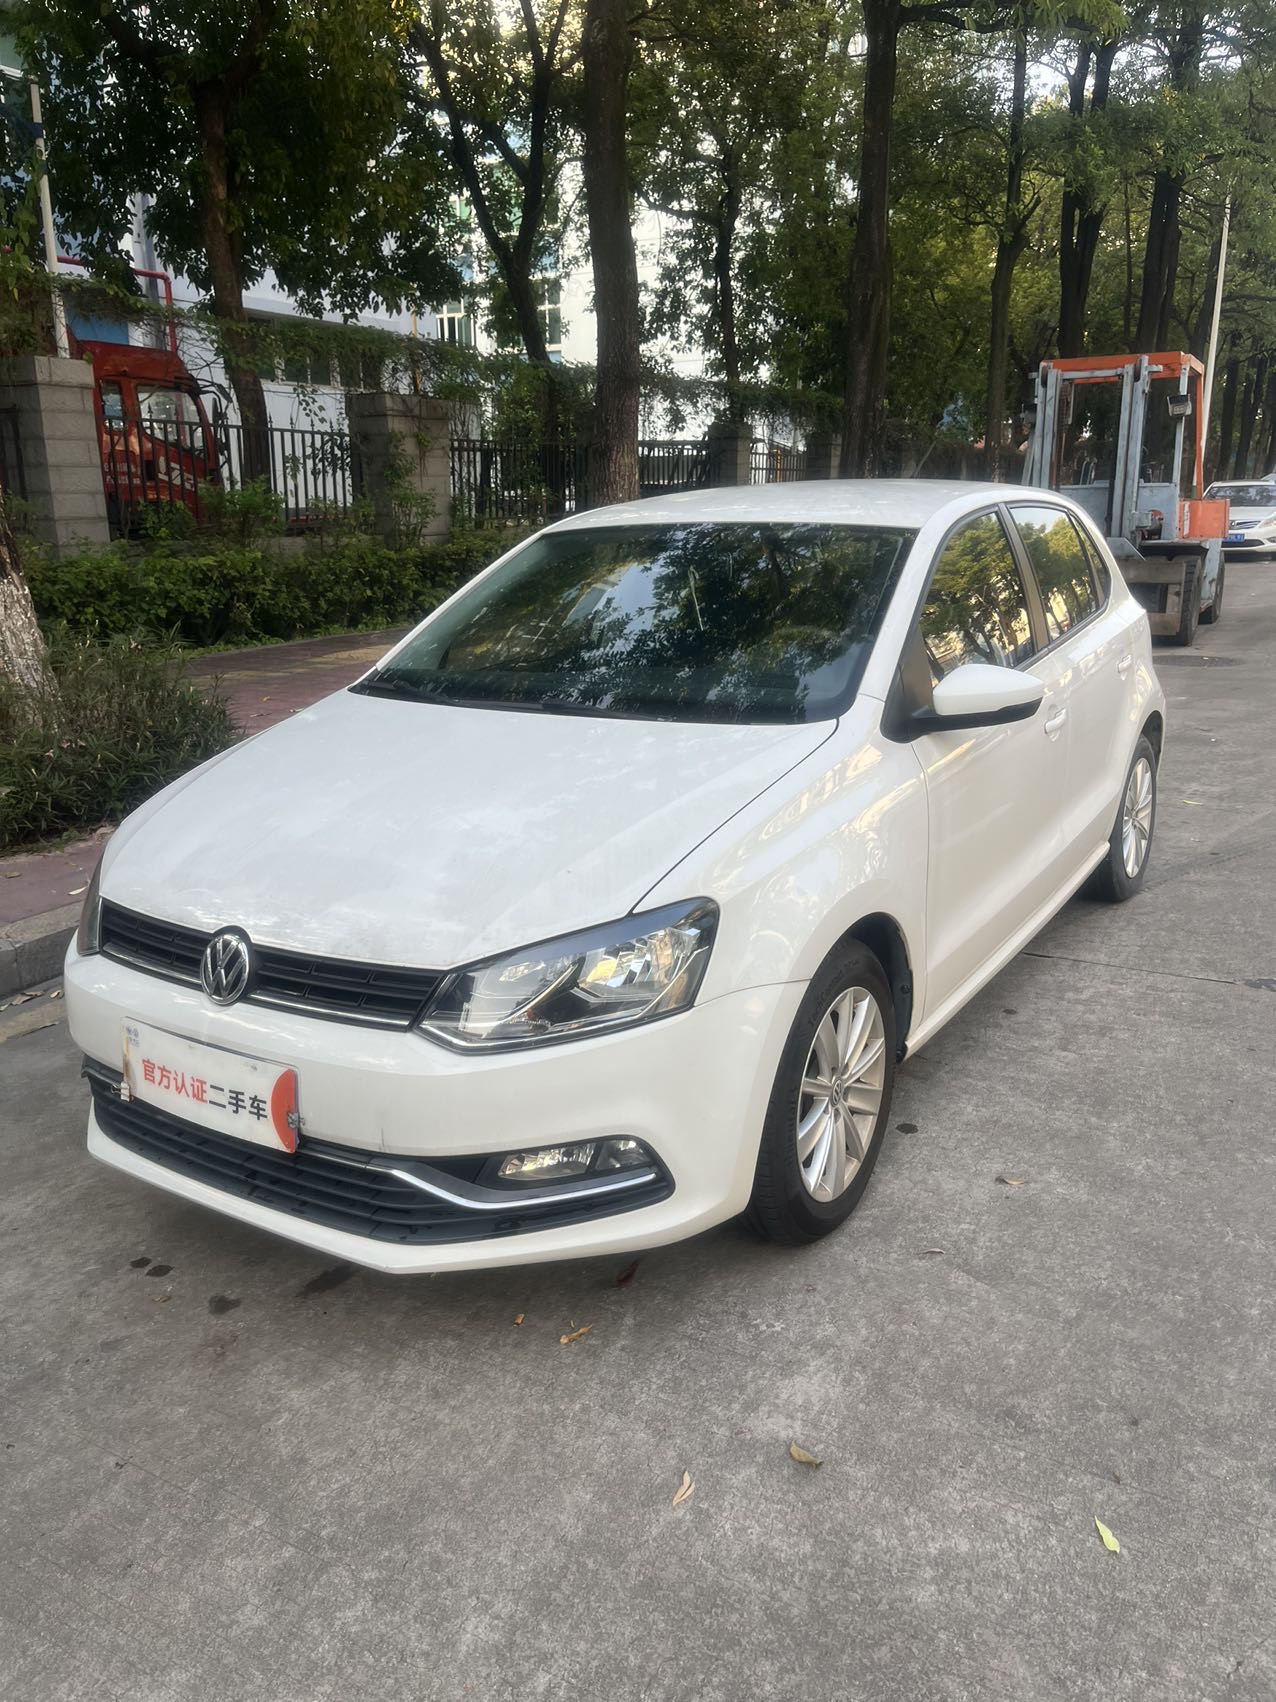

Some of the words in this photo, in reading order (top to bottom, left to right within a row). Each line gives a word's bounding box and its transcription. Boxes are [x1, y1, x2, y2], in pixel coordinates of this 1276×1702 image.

[142, 1058, 268, 1120] 官方认证二手车
